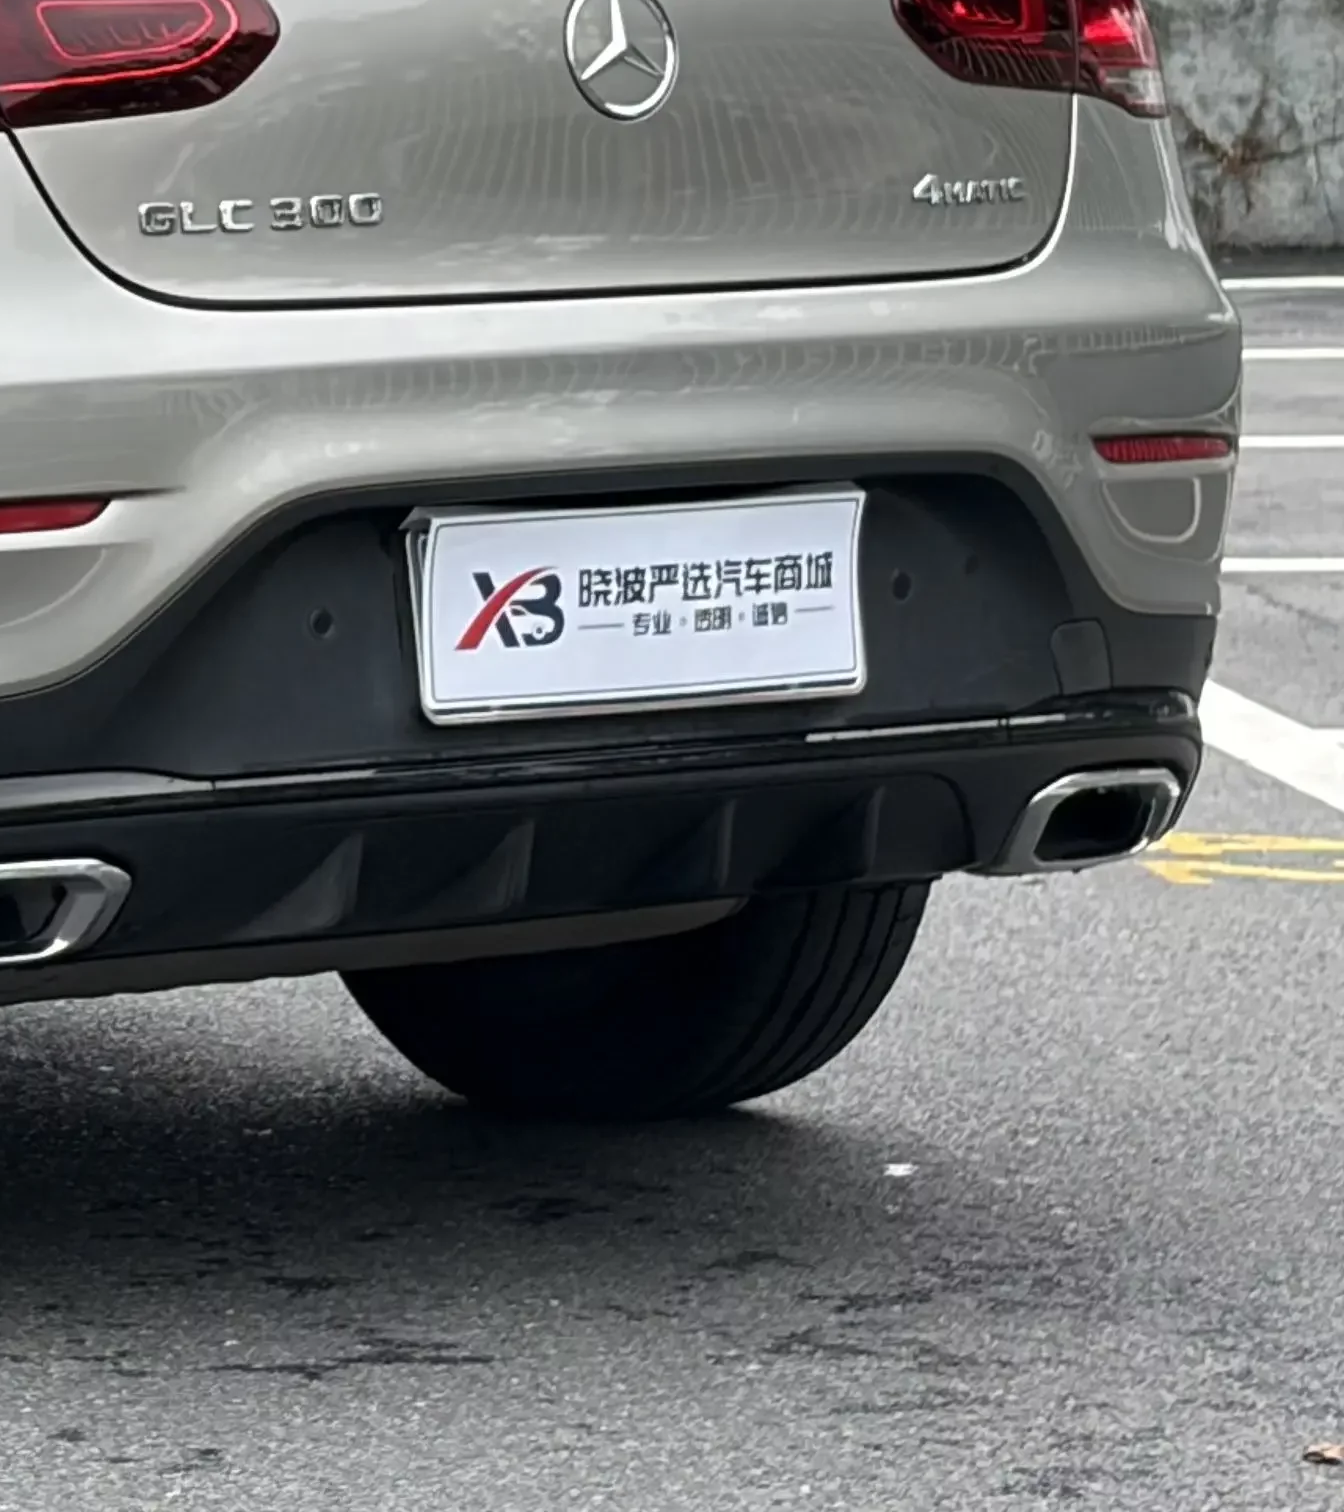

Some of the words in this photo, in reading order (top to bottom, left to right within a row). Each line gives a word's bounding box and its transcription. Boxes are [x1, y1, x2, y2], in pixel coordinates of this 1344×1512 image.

[912, 172, 1026, 205] 4MATIC
[137, 198, 257, 235] GLC
[269, 191, 384, 231] 300
[577, 550, 834, 608] 晓波严选汽车商城
